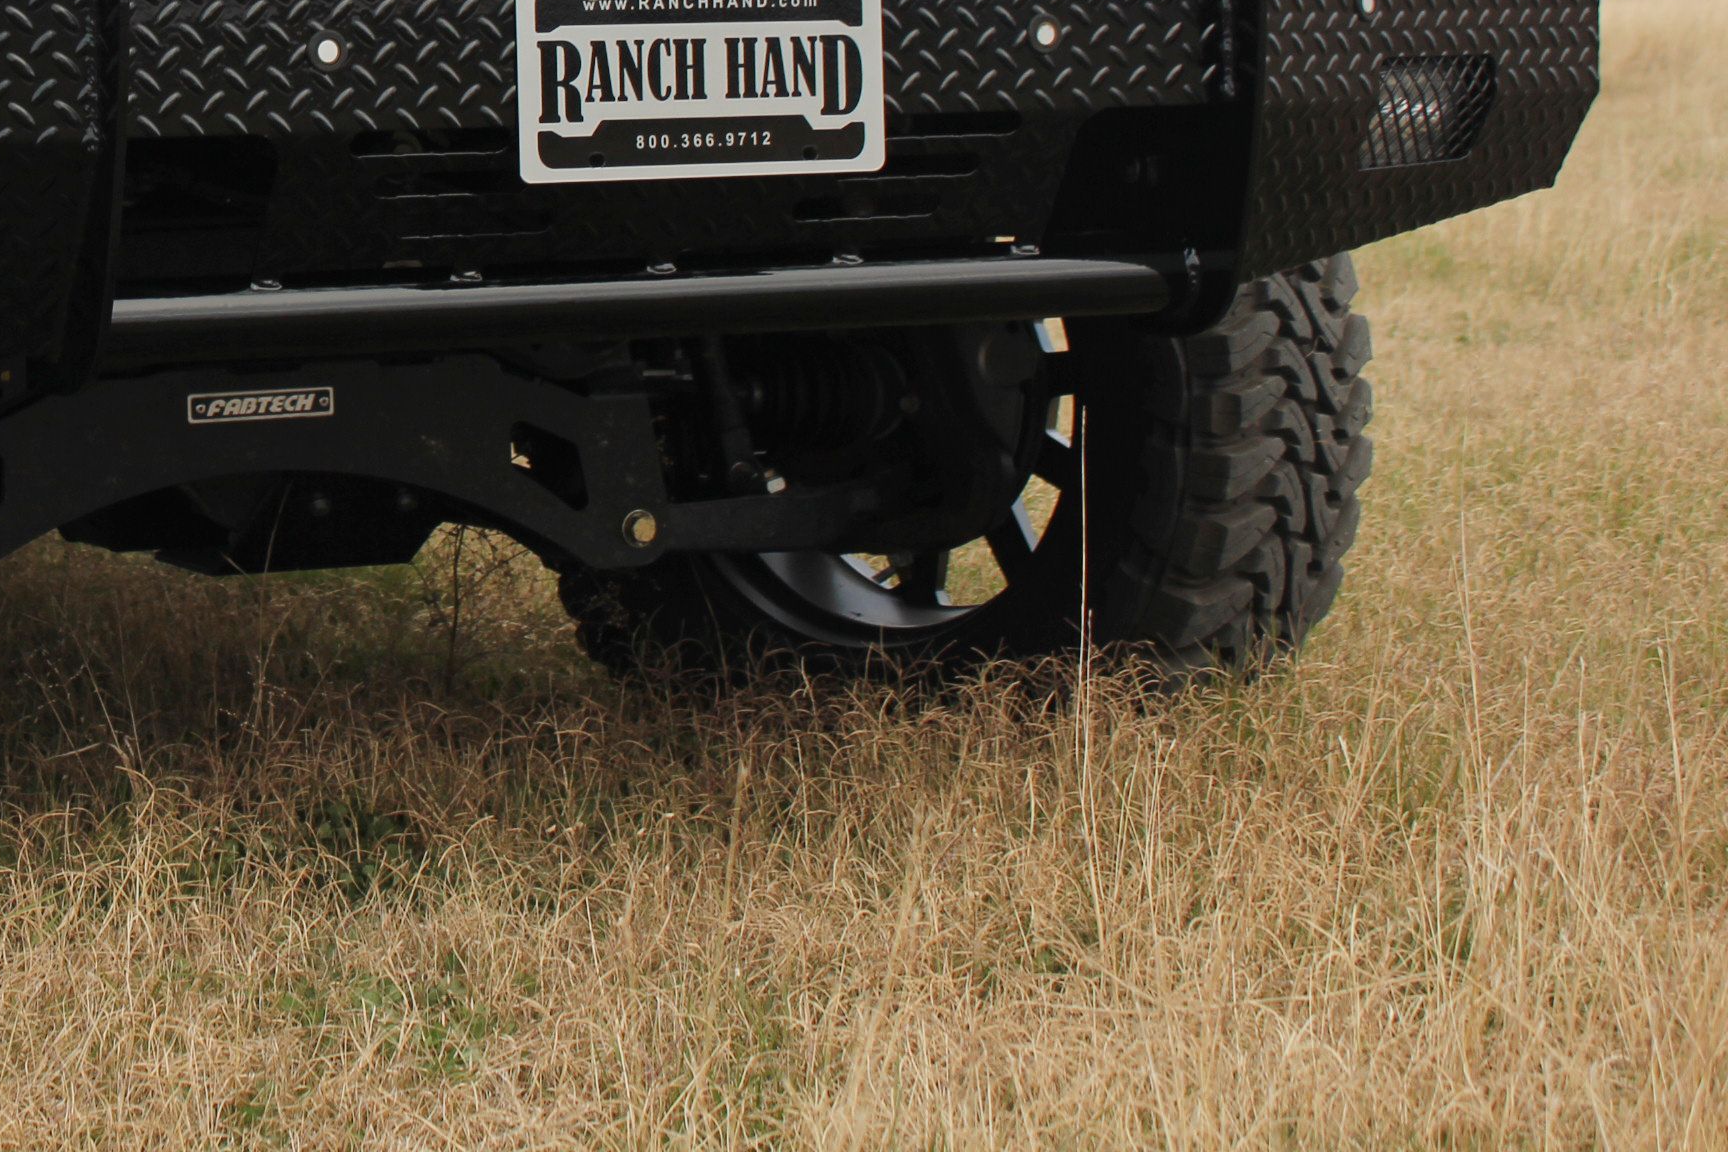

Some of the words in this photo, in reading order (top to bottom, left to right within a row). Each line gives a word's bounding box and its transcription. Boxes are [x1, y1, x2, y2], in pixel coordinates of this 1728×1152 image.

[536, 38, 708, 124] RANCH
[724, 34, 864, 116] HAND
[635, 131, 772, 150] 800.366.9712
[207, 393, 316, 417] FABTECH
